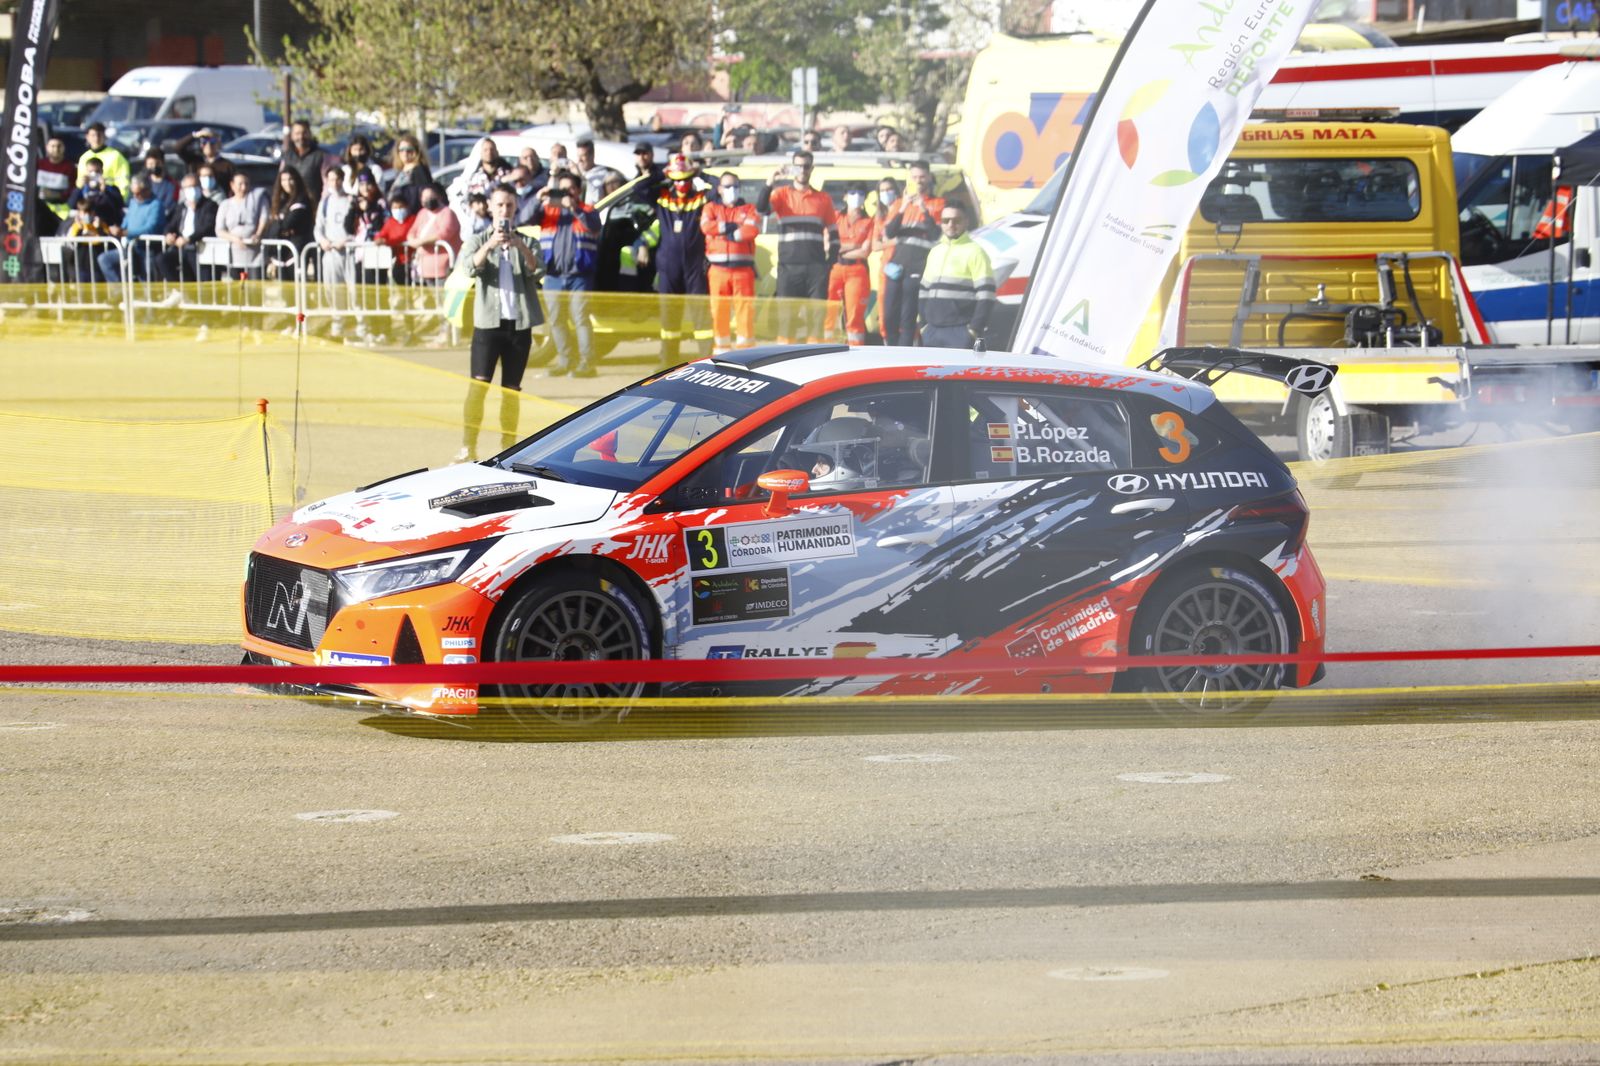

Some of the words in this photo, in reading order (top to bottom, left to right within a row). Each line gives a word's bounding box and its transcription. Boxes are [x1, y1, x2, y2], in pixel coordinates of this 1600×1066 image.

[1224, 1, 1295, 97] DEPORTE
[1207, 34, 1248, 89] Región
[6, 47, 37, 185] CÓRDOBA
[1242, 129, 1305, 141] GRUAS
[1312, 128, 1377, 140] MATA
[1059, 330, 1069, 340] de
[1069, 334, 1107, 356] Andalucía
[684, 370, 770, 393] HYUNDAI
[1014, 423, 1090, 443] P.López
[1154, 411, 1192, 464] 3
[1017, 446, 1111, 464] B.Rozada
[1153, 471, 1269, 491] HYUNDAI
[776, 524, 841, 541] PATRIMONIO
[625, 534, 676, 560] JHK
[697, 529, 719, 569] 3
[777, 534, 852, 553] HUMANIDAD
[755, 600, 788, 609] IMDECO
[441, 616, 474, 632] JHK
[1040, 596, 1110, 640] Comunidad
[1046, 637, 1064, 652] de
[1064, 607, 1118, 642] Madrid
[444, 639, 474, 647] PHILIPS
[744, 646, 829, 658] RALLYE
[441, 688, 477, 698] PAGID
